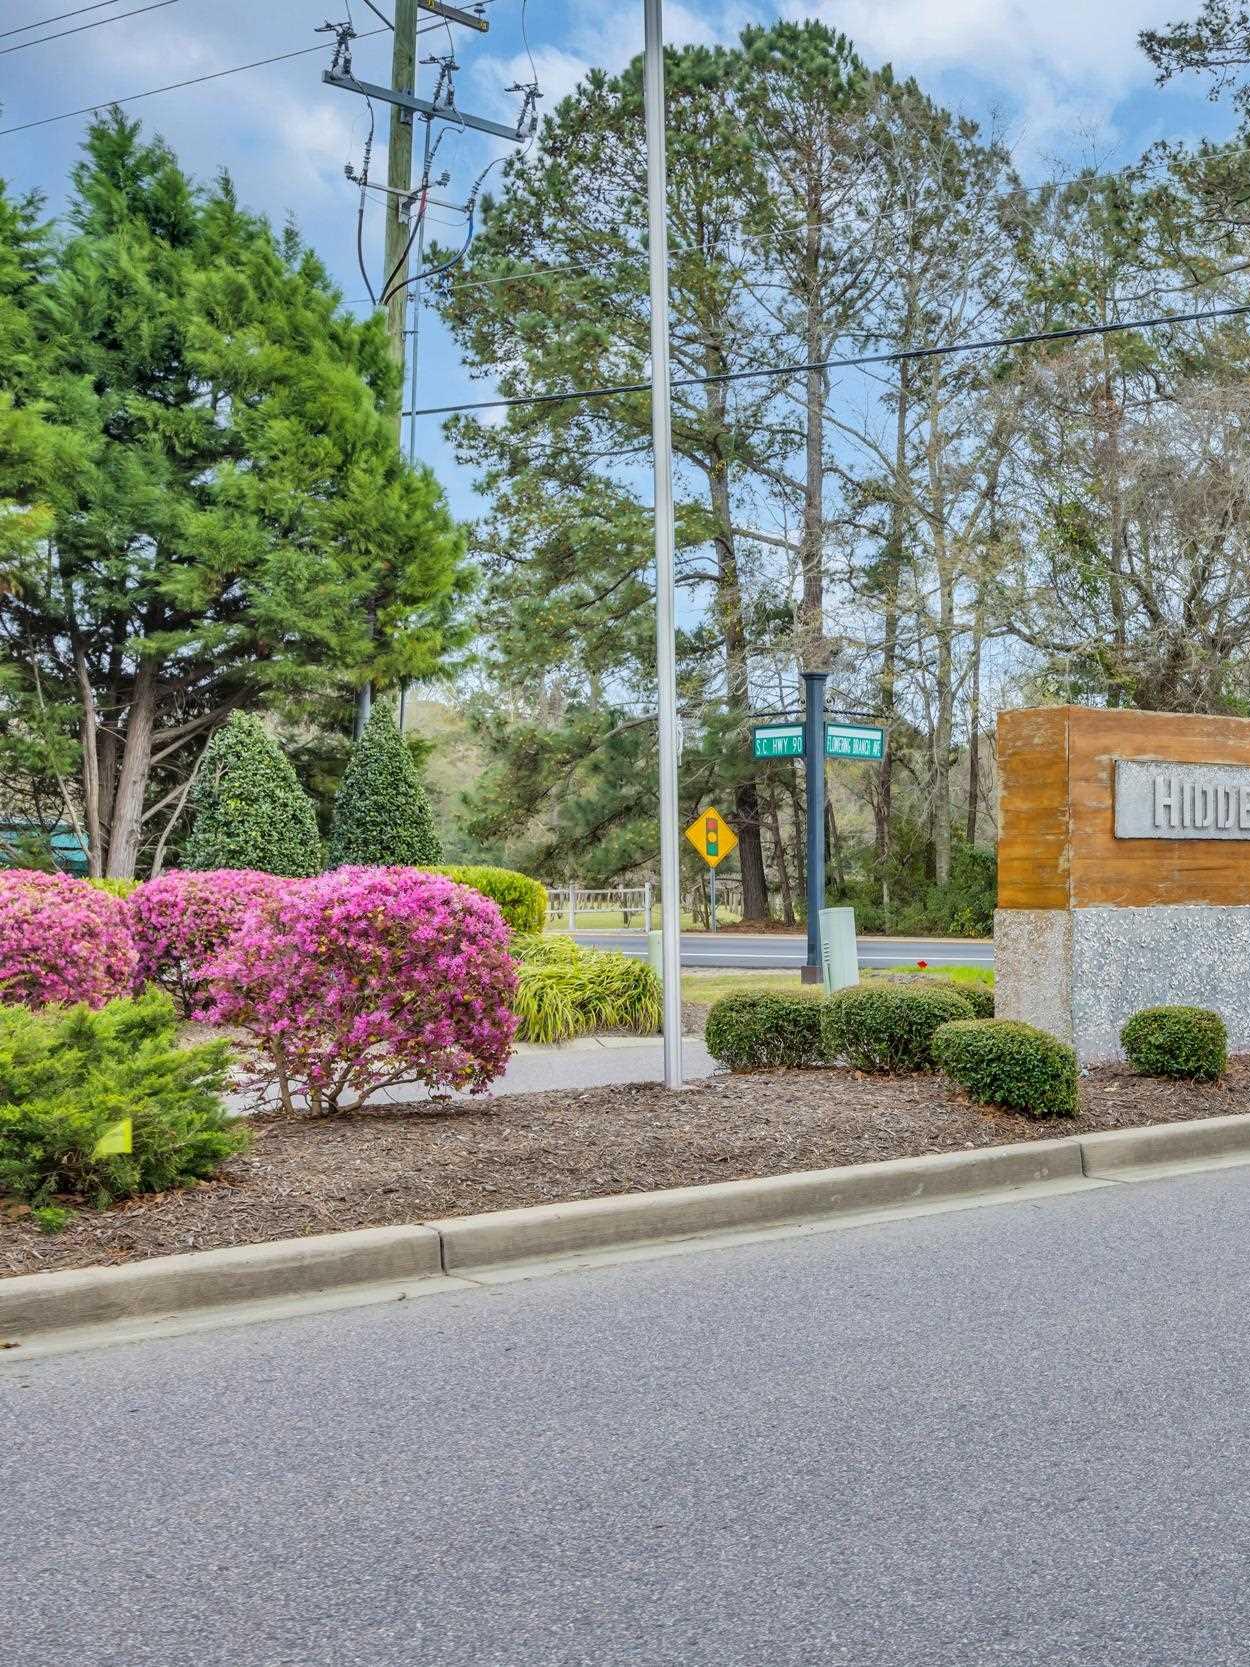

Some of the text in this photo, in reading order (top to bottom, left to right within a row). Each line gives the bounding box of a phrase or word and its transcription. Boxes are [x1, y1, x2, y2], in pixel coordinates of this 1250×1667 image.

[772, 738, 788, 754] HWY
[792, 736, 802, 752] 90
[853, 737, 870, 755] BRANCH
